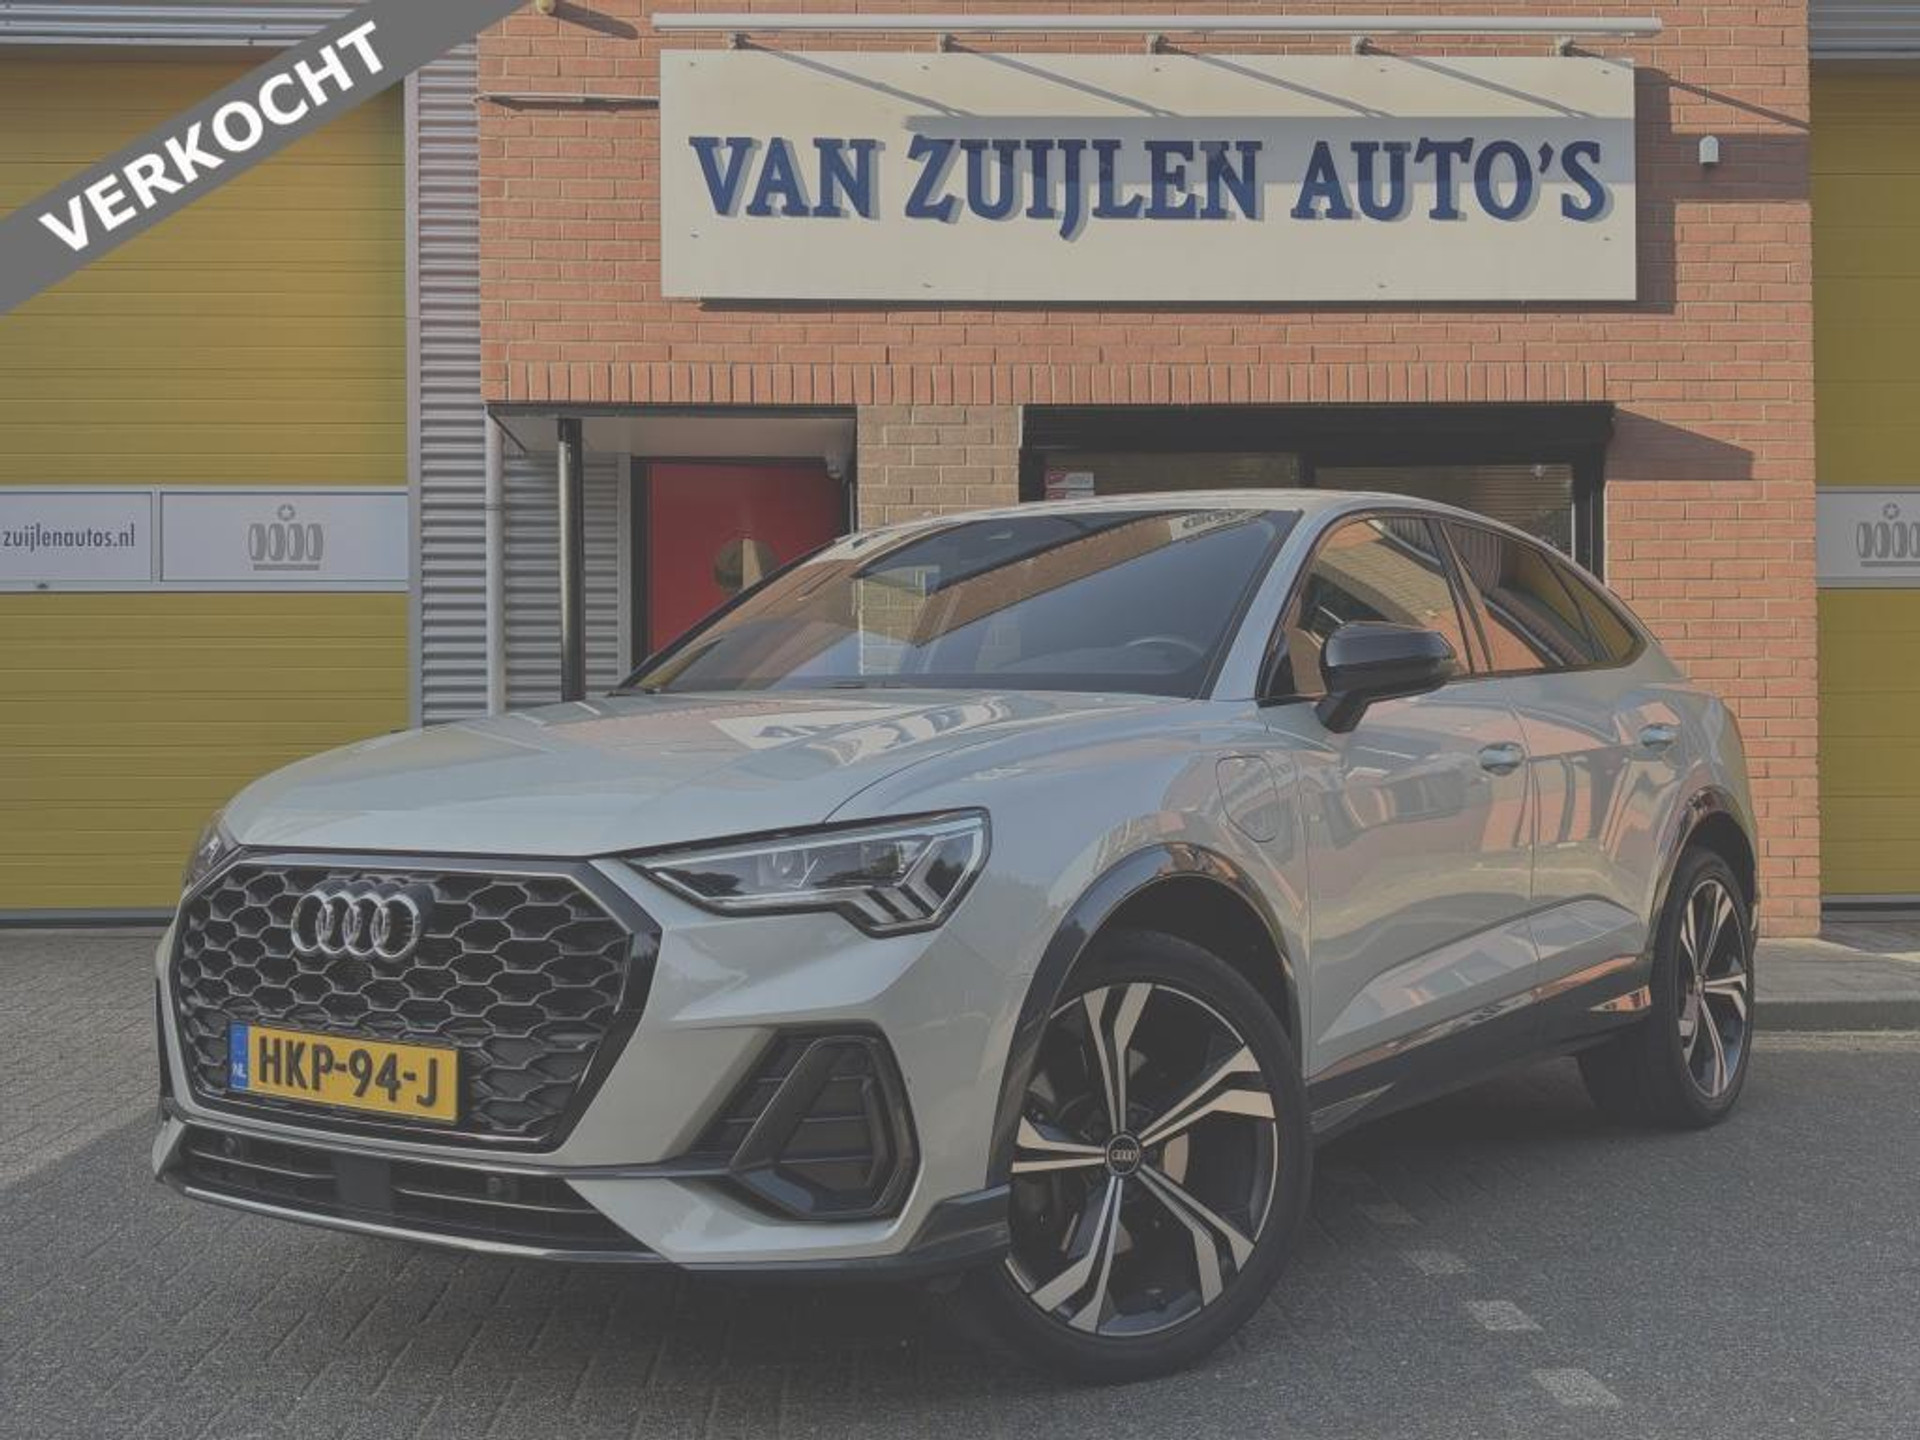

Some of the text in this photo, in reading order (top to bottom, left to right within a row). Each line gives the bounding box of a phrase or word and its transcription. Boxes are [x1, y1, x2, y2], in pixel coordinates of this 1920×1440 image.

[688, 133, 1612, 242] VAN ZUIJLEN AUTO'S
[2, 521, 135, 553] zuijlenautos.nl
[232, 1063, 247, 1079] NL
[258, 1035, 439, 1109] HKP-94-J
